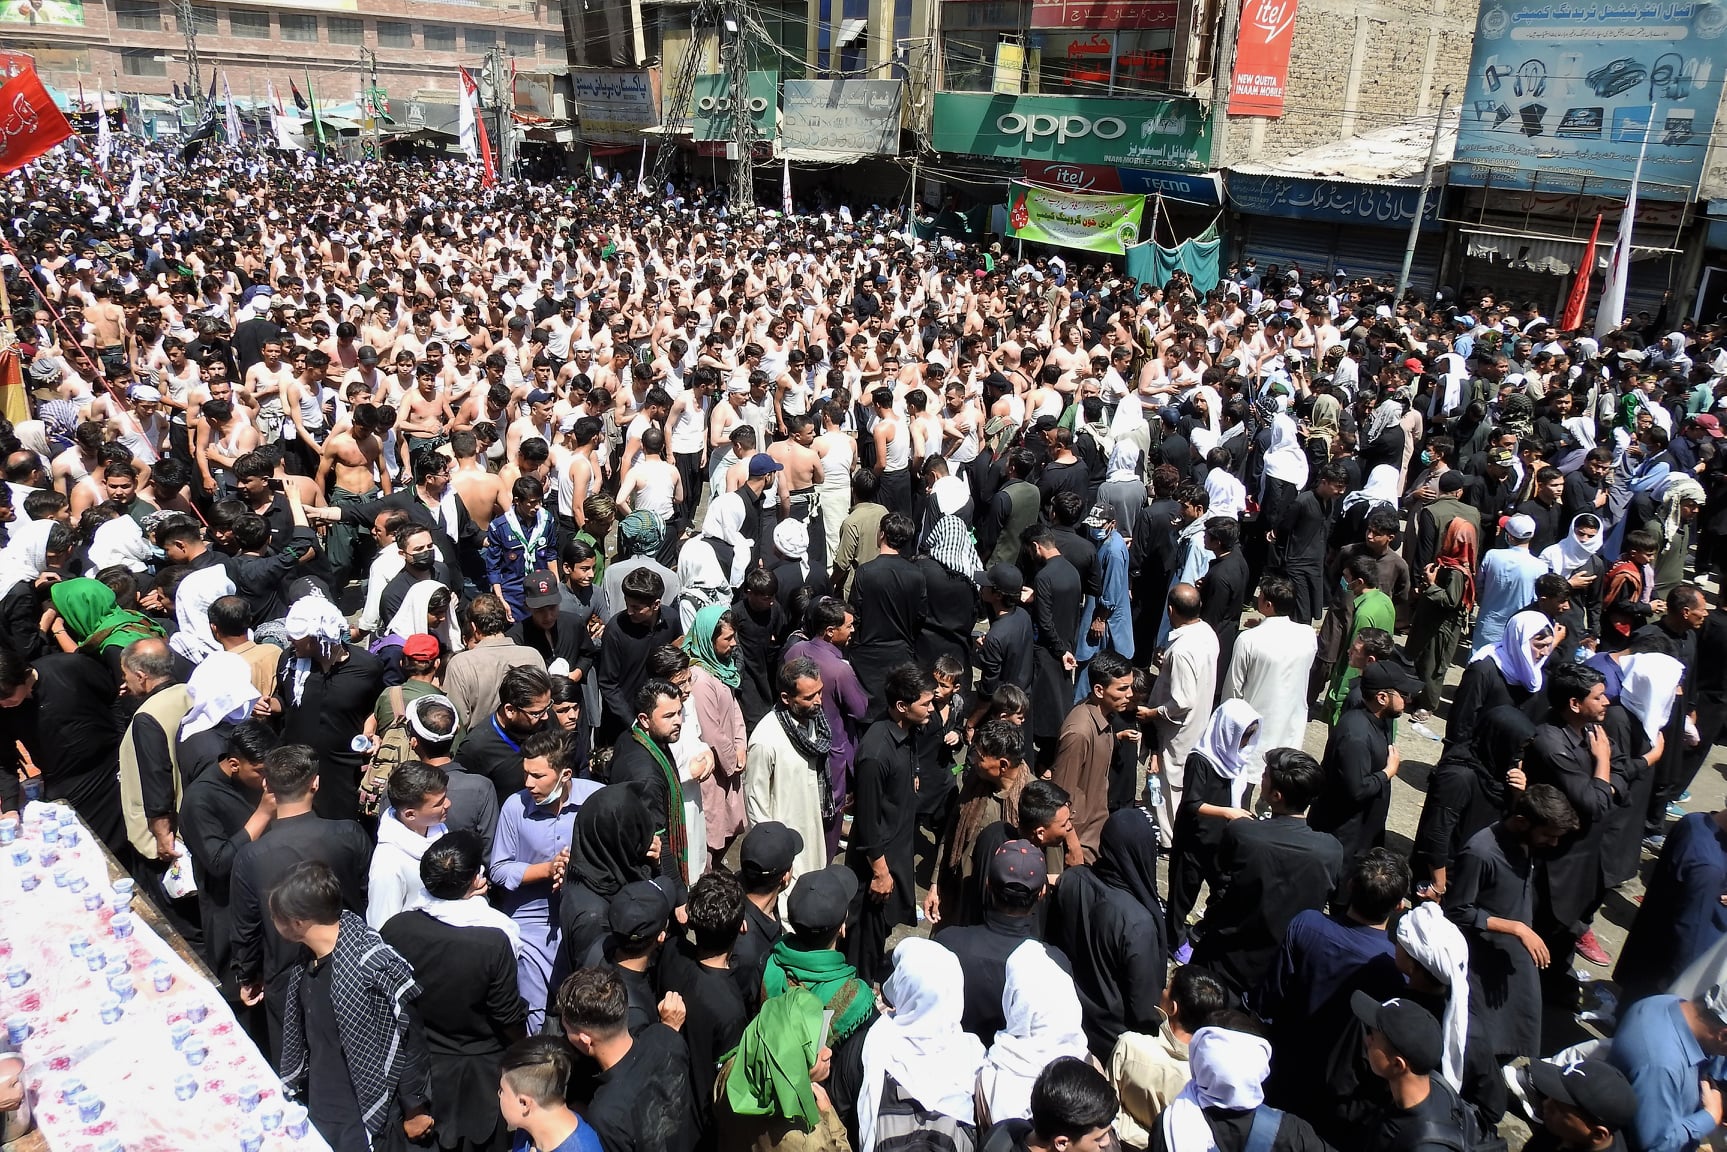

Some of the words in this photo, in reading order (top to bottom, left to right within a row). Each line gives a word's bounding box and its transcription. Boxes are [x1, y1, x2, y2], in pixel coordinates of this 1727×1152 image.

[1067, 33, 1111, 61] حکیم
[593, 75, 614, 99] بریانی
[614, 74, 647, 99] پاکستان
[1237, 73, 1254, 85] NEW
[1254, 75, 1277, 87] QUETTA
[1236, 84, 1259, 96] INAAM
[1260, 87, 1283, 97] MOBILE
[996, 112, 1127, 144] oppo
[1103, 154, 1122, 163] INAM
[1122, 156, 1151, 165] MOBILE
[1167, 144, 1199, 161] موبائل
[1056, 168, 1085, 183] itel
[1568, 167, 1596, 175] Website
[1142, 177, 1191, 193] TECNO
[1082, 217, 1097, 228] خون
